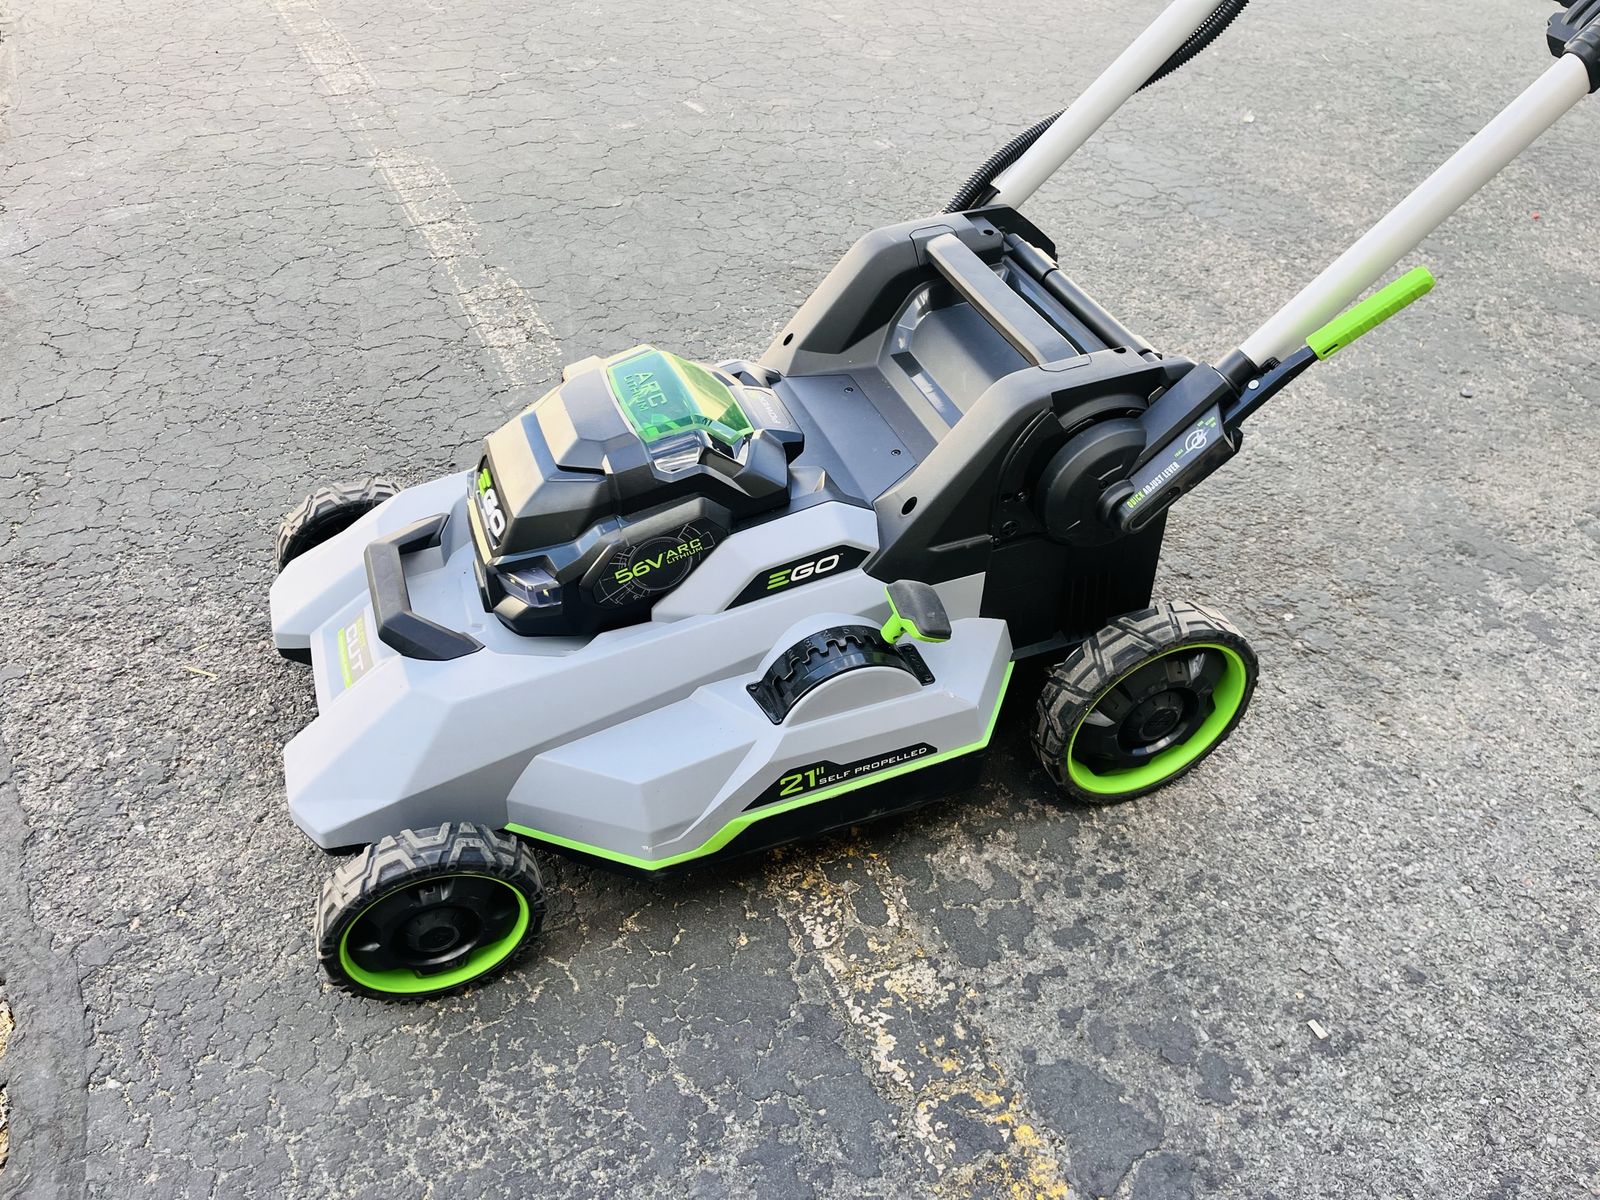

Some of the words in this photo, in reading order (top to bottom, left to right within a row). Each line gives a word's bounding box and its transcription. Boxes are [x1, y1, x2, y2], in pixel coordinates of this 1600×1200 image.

[635, 372, 668, 407] ARC
[478, 468, 505, 537] EGO
[1126, 491, 1145, 508] QUICK
[1142, 475, 1164, 495] ADJUST
[1161, 461, 1180, 479] LEVER
[614, 553, 663, 584] 56V
[666, 538, 702, 560] ARC
[667, 546, 703, 564] LITHIUM
[767, 554, 840, 589] EGO
[346, 623, 364, 670] CUT
[819, 770, 851, 785] SELF
[854, 747, 927, 774] PROPELLED
